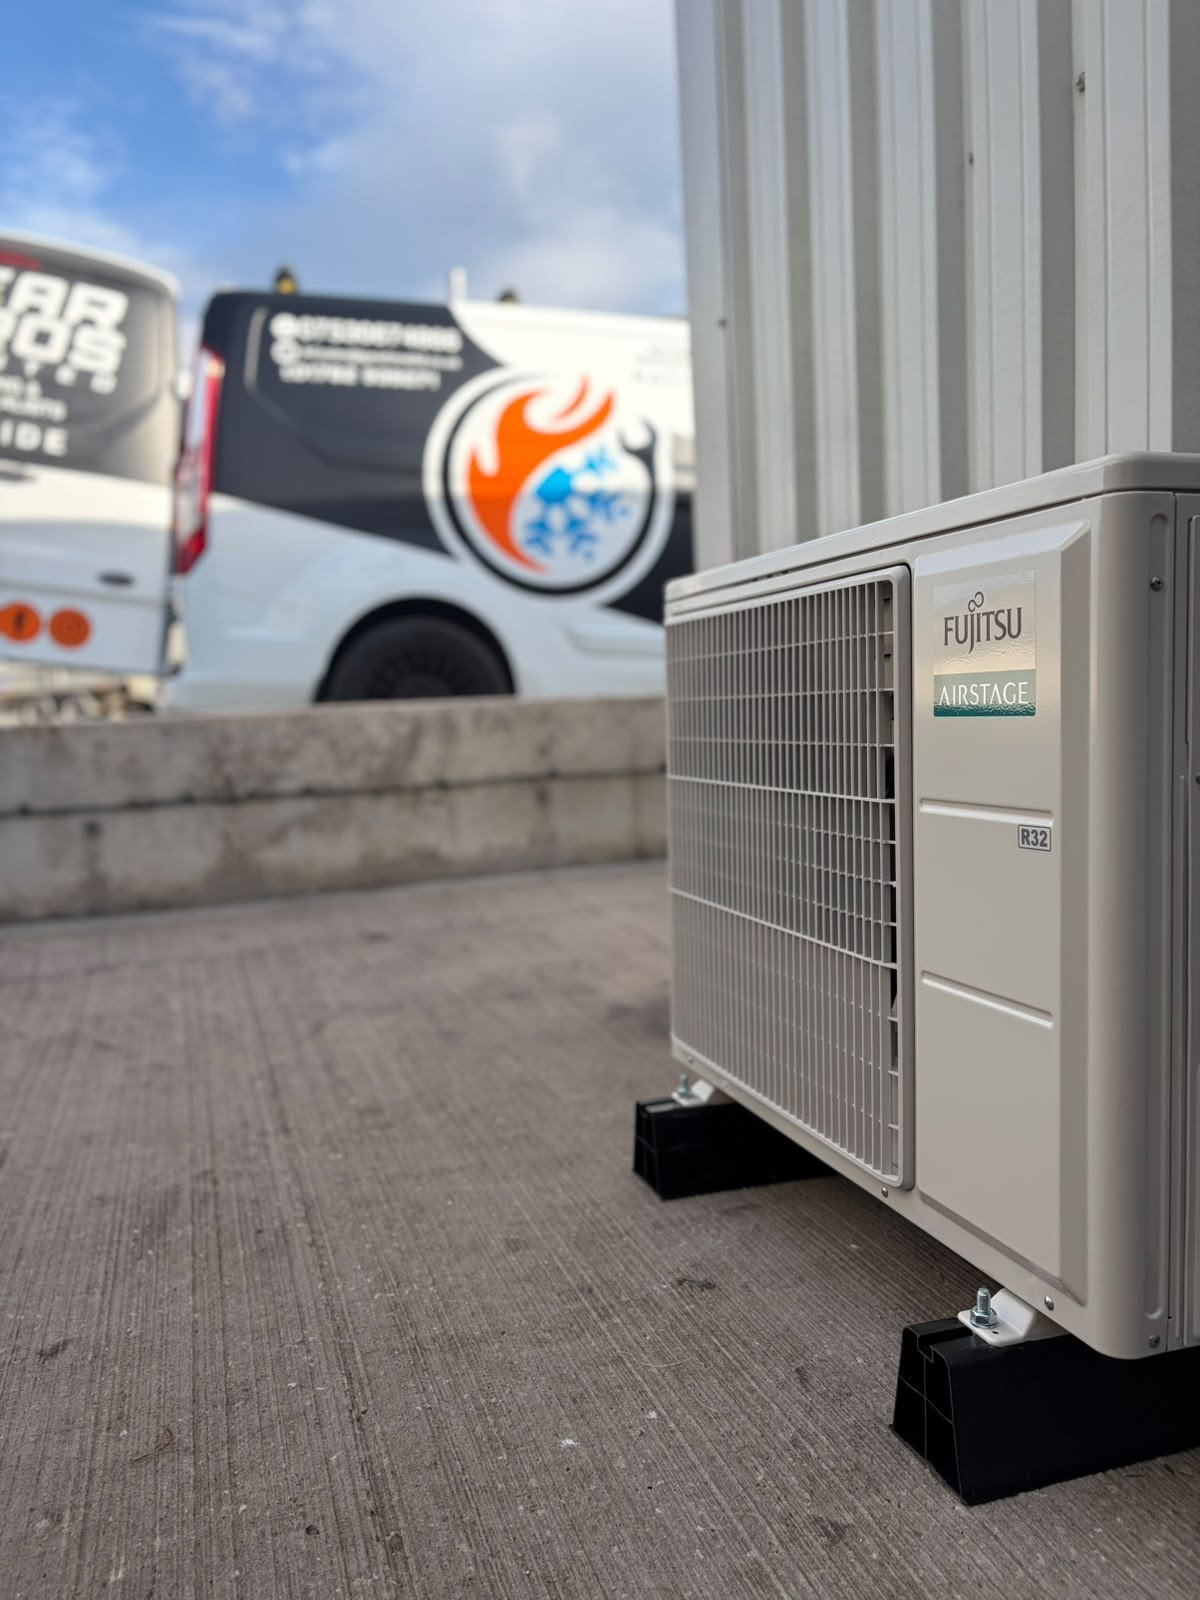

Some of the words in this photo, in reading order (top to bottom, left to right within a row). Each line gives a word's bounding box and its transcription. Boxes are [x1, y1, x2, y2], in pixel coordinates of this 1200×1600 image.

[944, 604, 1022, 654] FUJITSU
[939, 681, 1029, 706] AIRSTAGE
[1021, 828, 1048, 849] R32
